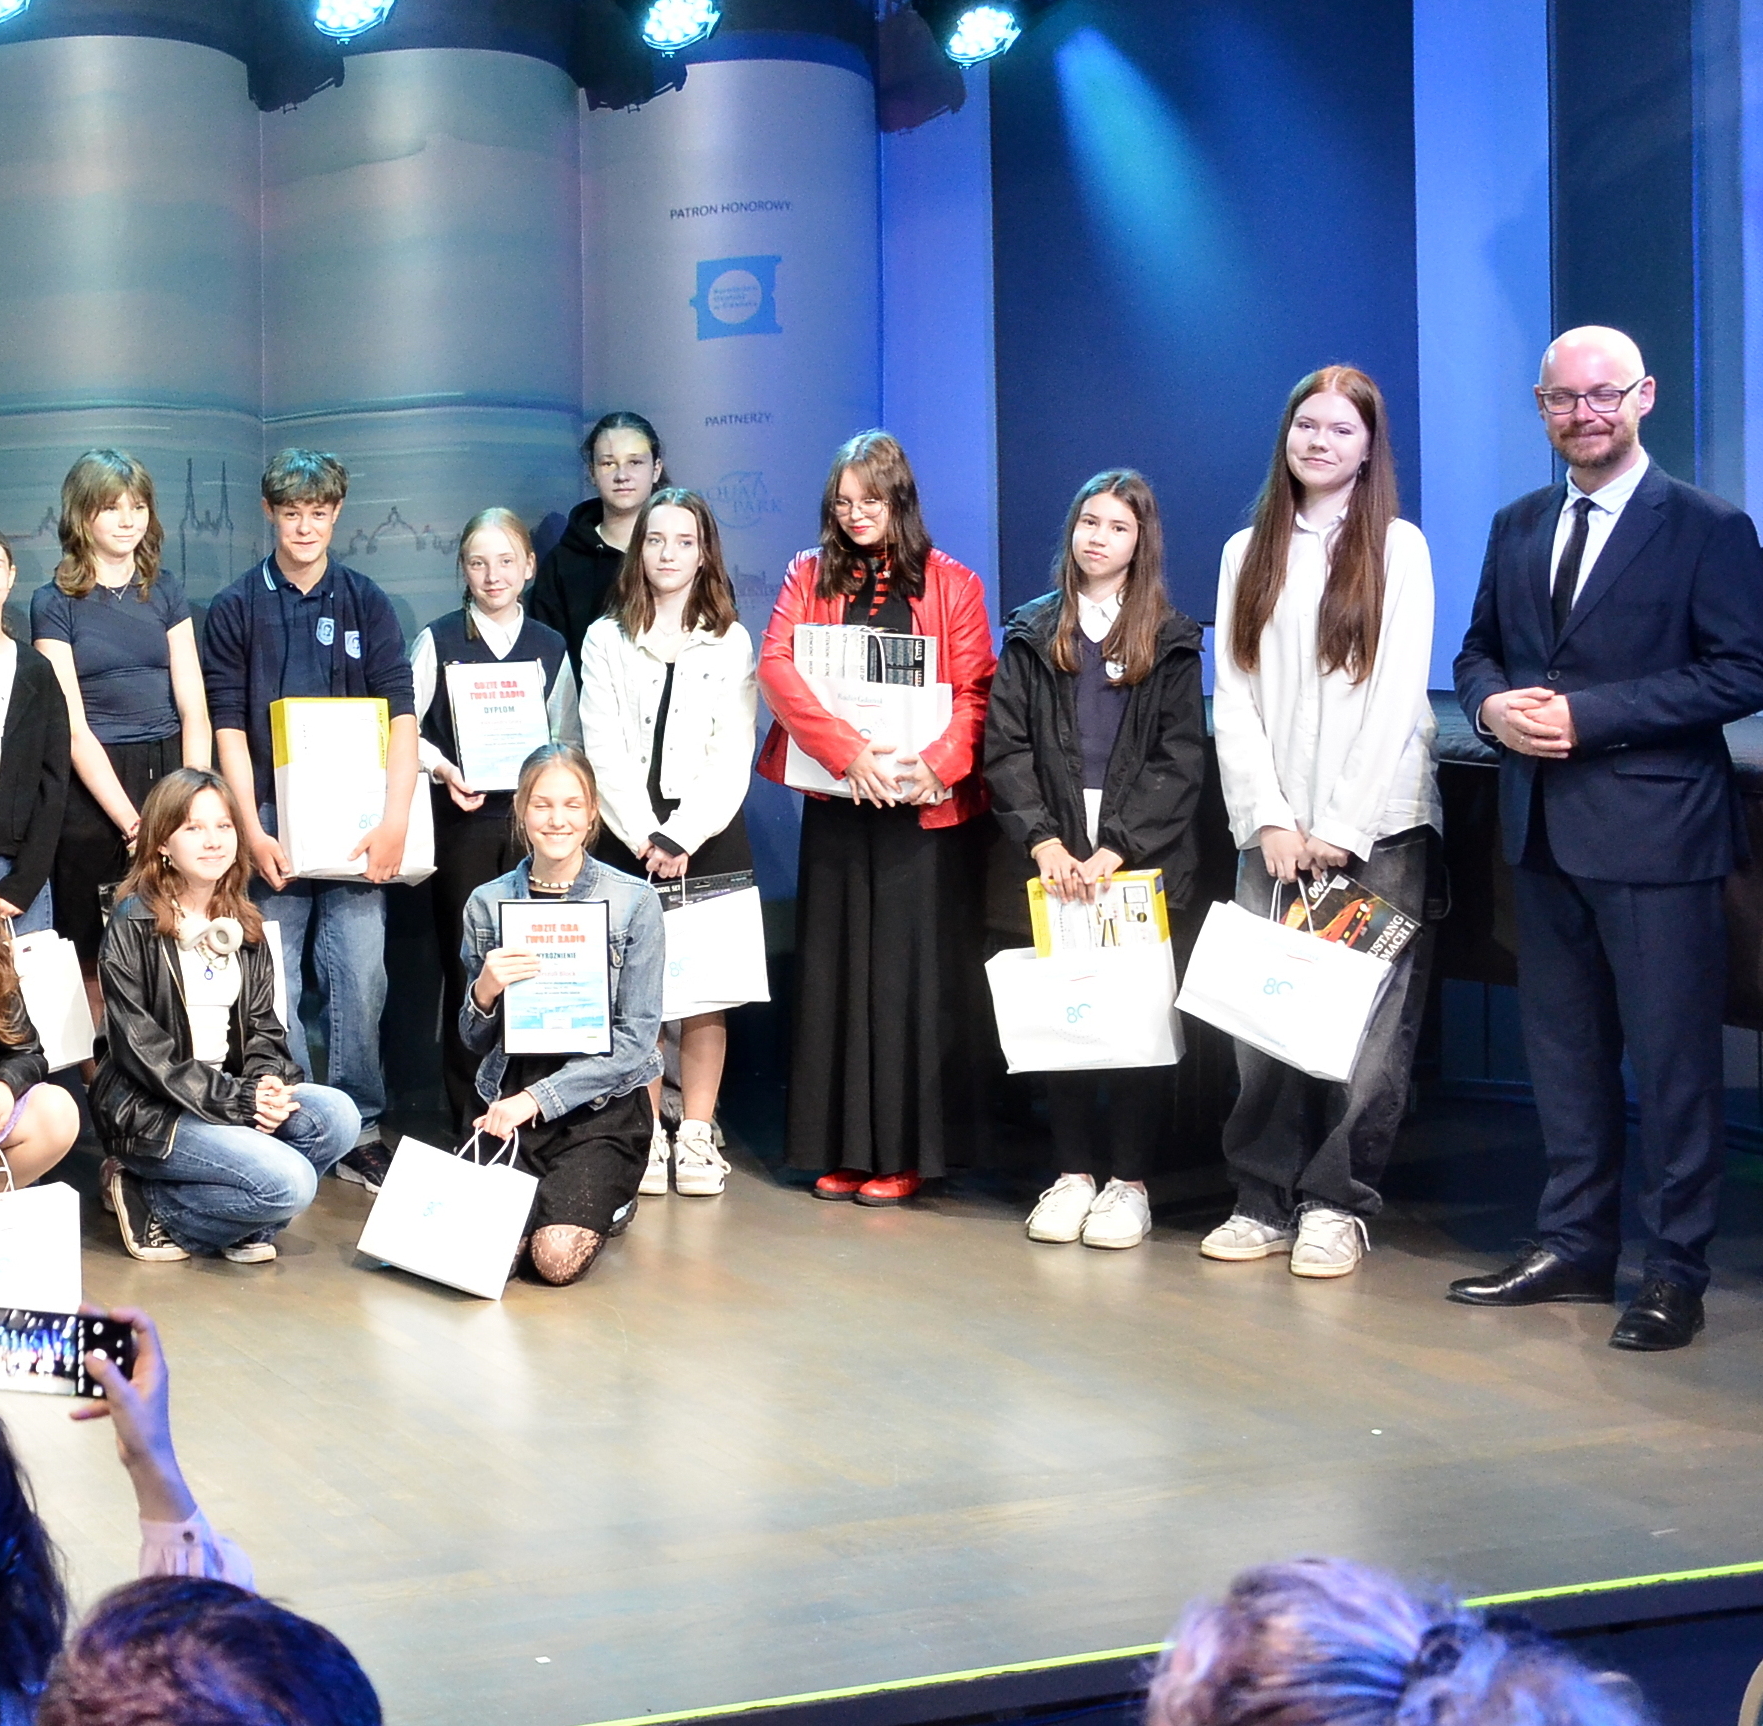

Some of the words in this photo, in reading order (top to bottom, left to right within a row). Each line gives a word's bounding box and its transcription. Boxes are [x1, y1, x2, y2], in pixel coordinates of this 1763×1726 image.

[670, 205, 718, 219] PATRON
[483, 706, 516, 714] DYPLOM
[1366, 914, 1405, 957] USTANG
[1379, 927, 1411, 961] MACH
